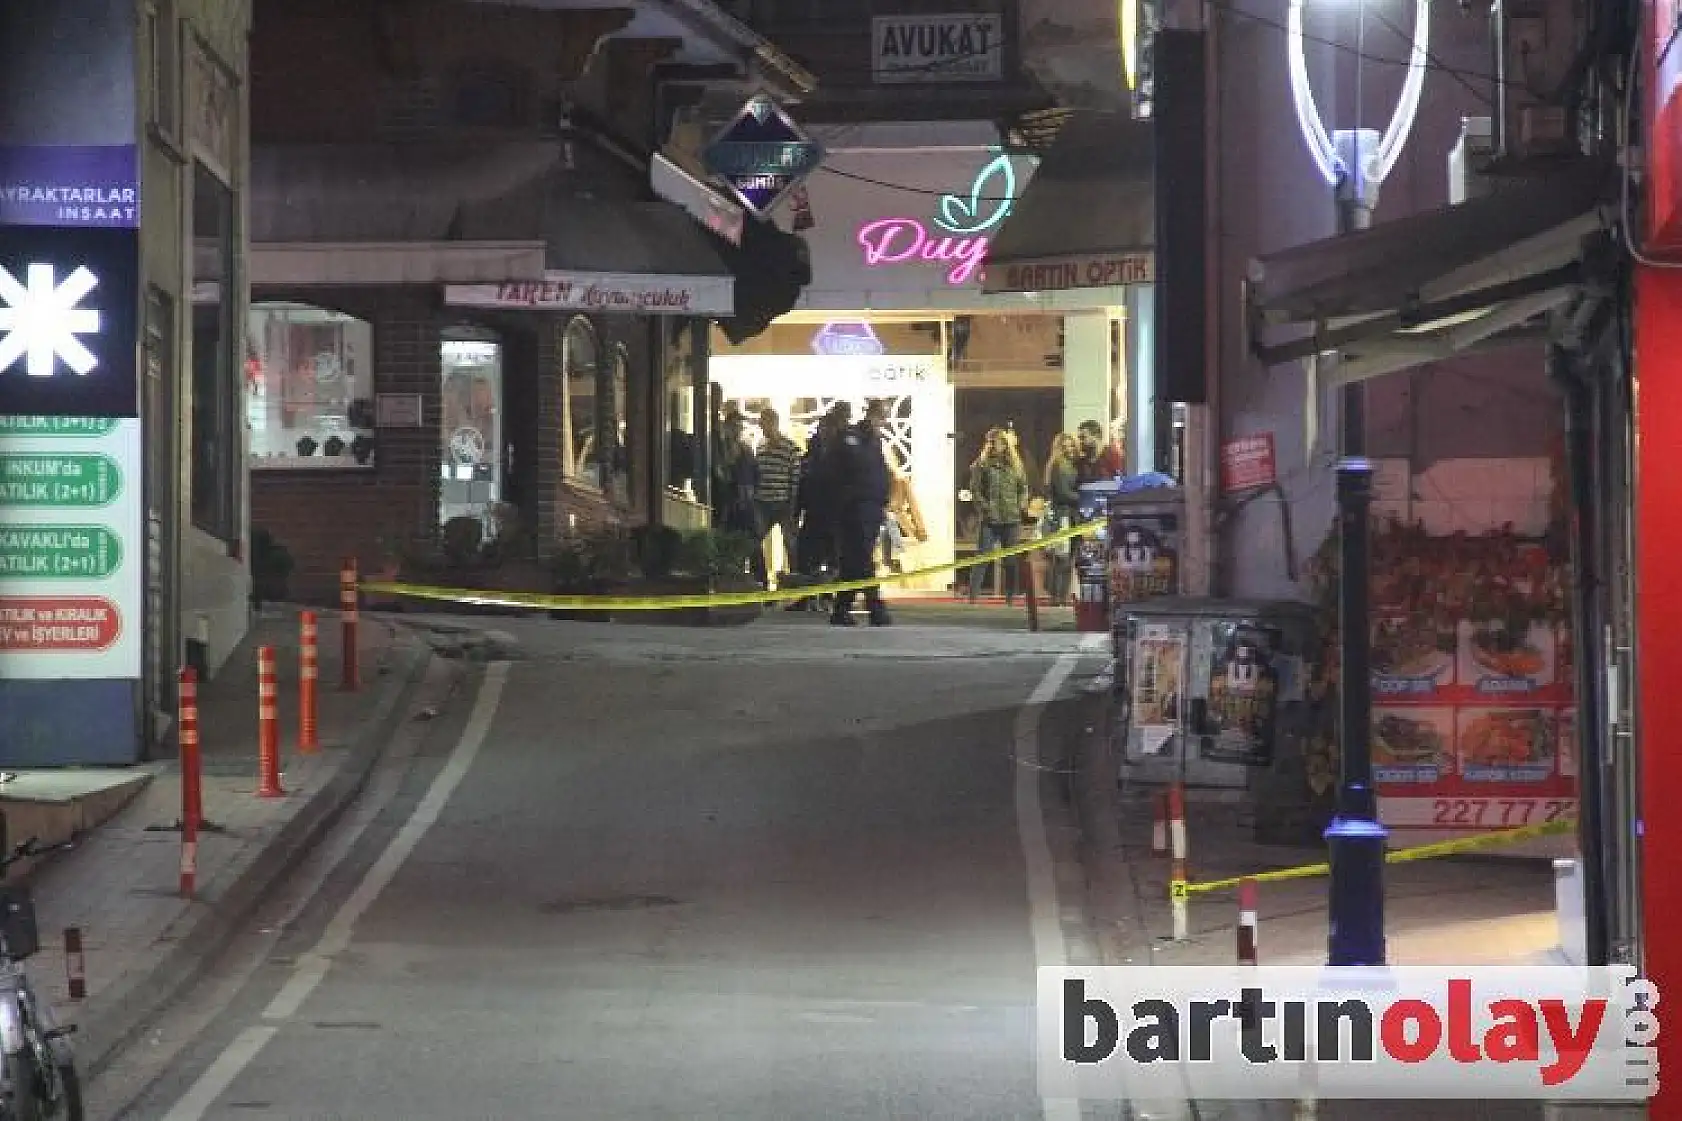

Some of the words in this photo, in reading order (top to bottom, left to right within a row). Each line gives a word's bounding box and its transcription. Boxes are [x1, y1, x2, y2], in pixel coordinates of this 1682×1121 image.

[881, 22, 992, 57] AVUKAT
[54, 481, 96, 502] (2+1)
[54, 552, 96, 574] (2+1)
[1433, 801, 1488, 824] 227
[1498, 801, 1535, 824] 77
